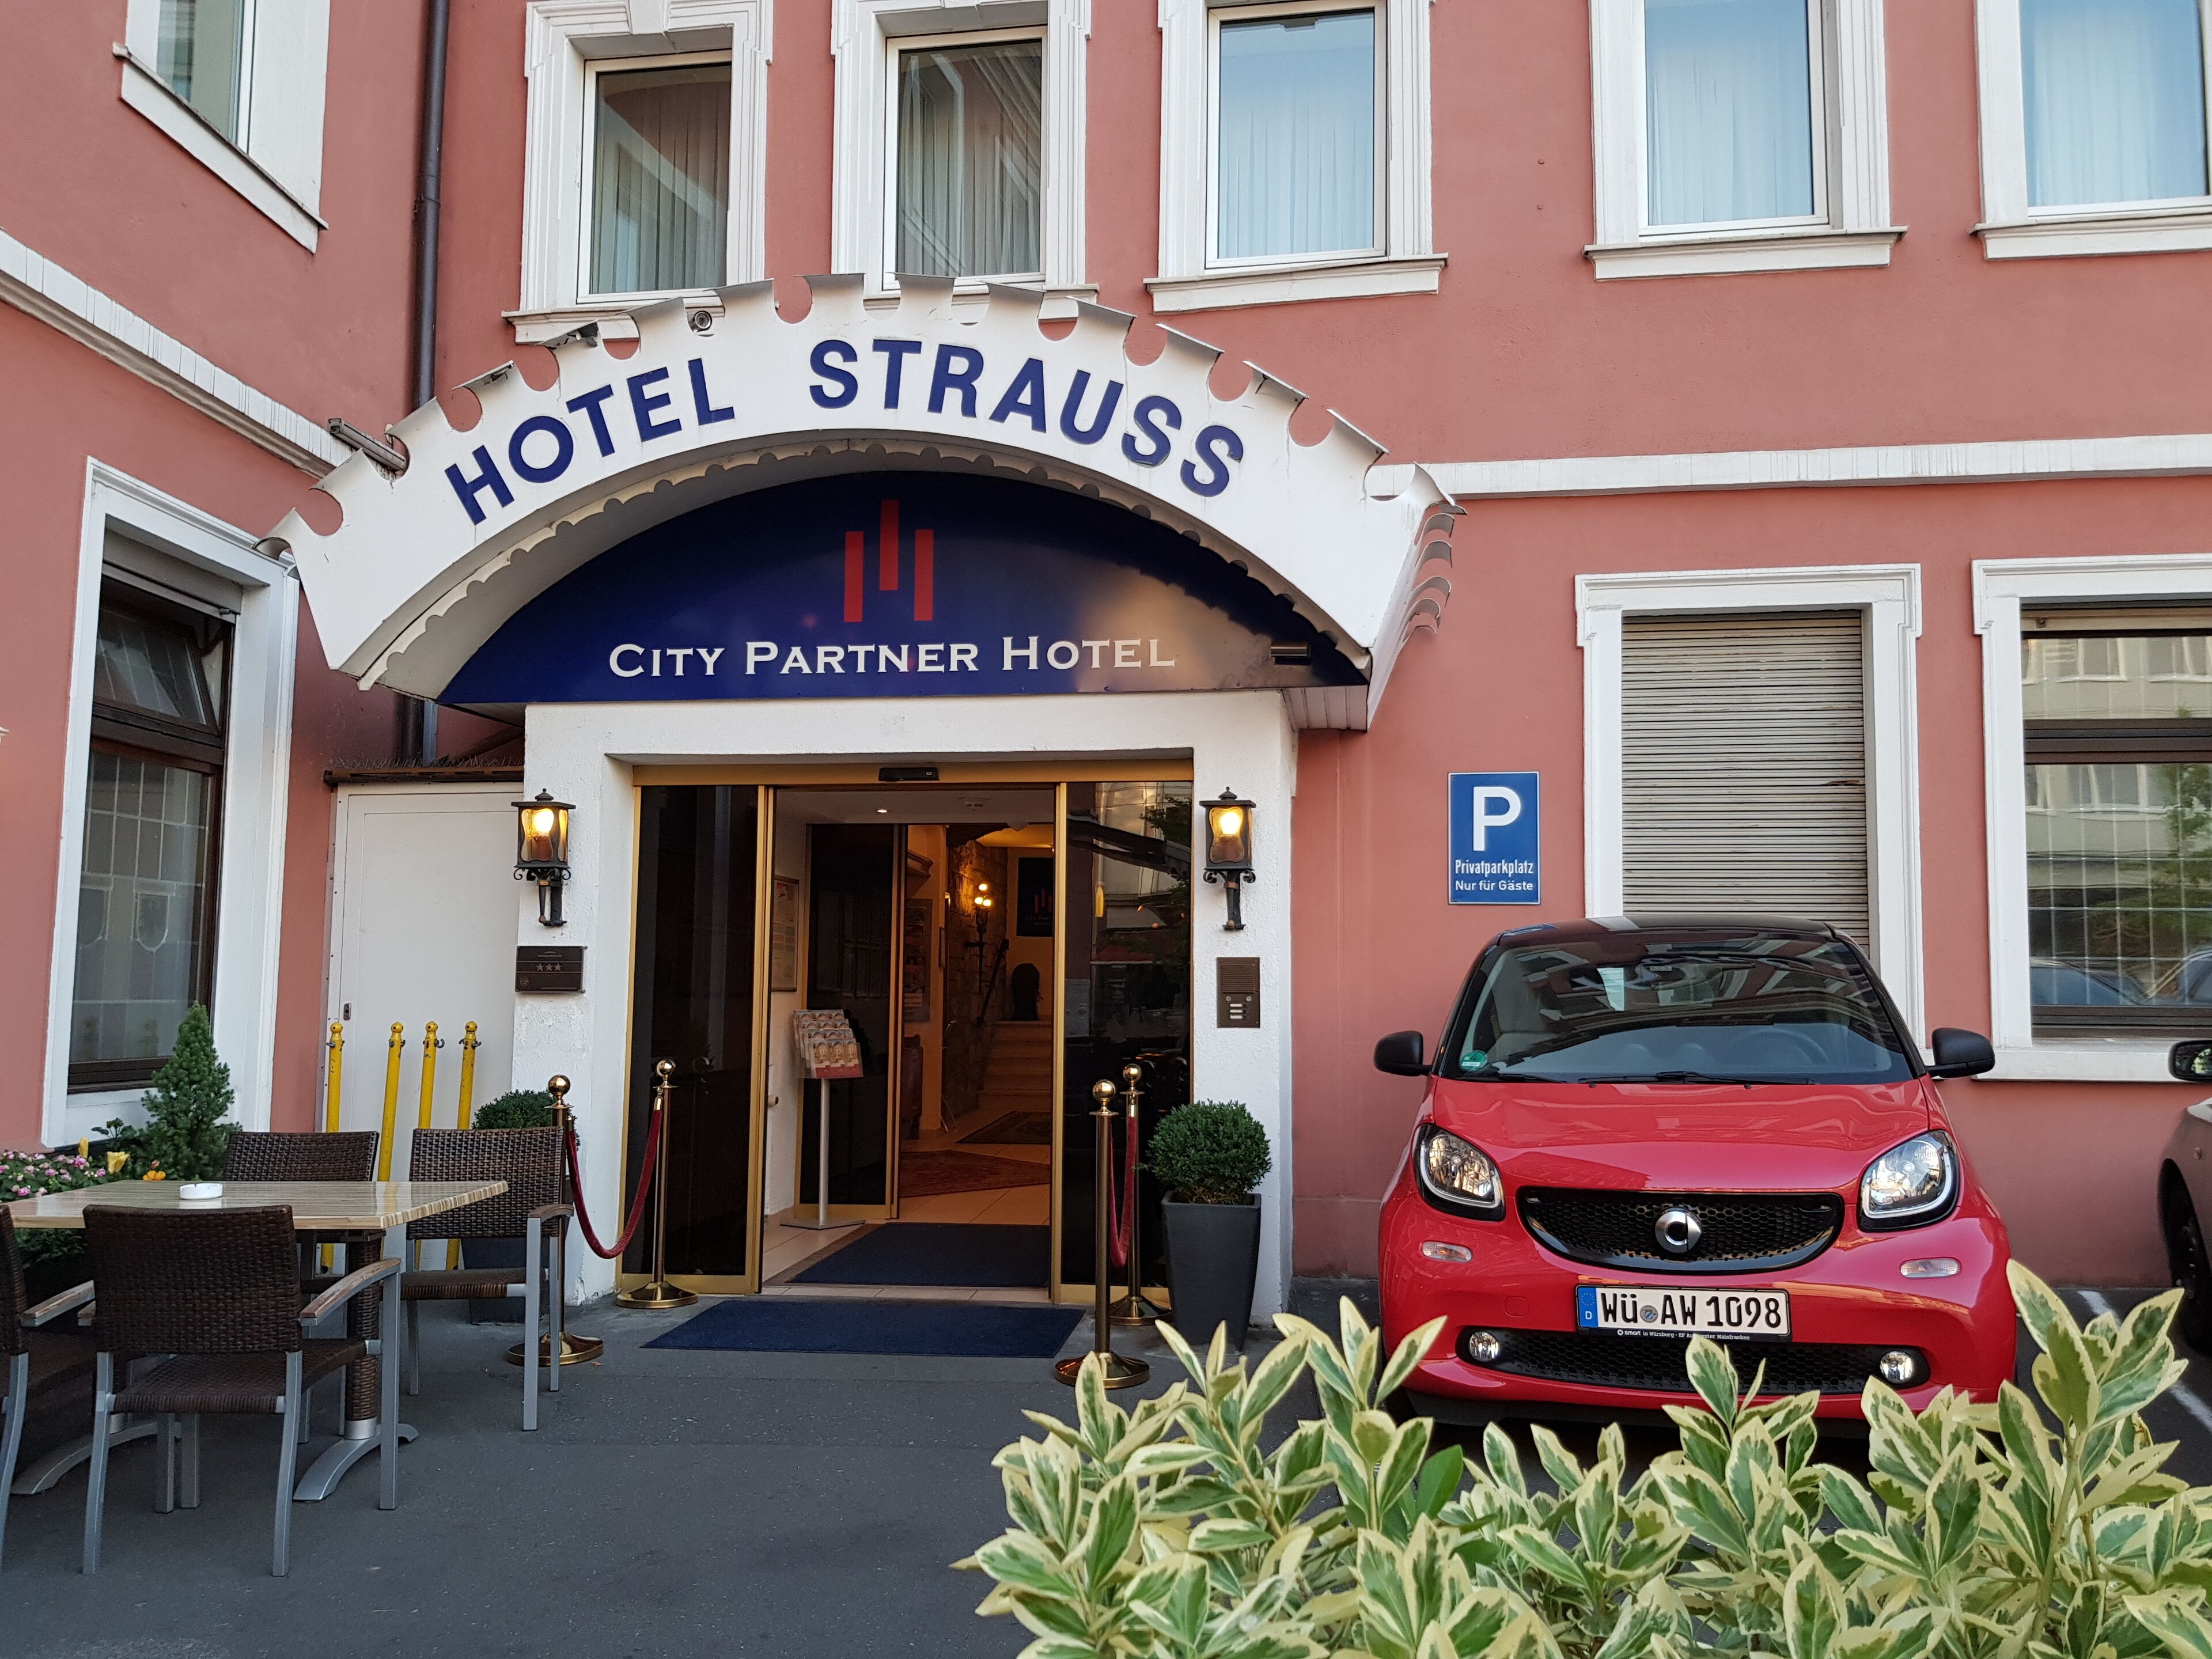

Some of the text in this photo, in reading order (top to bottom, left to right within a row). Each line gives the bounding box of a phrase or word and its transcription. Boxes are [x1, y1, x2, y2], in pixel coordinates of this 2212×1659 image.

[444, 339, 1244, 525] HOTEL STRAUSS
[1473, 786, 1521, 851] P
[1455, 859, 1533, 877] Privatparkplatz
[1455, 880, 1533, 891] Nur für Gäste
[1585, 1311, 1592, 1320] D
[1601, 1293, 1781, 1328] WÜ AW 1098
